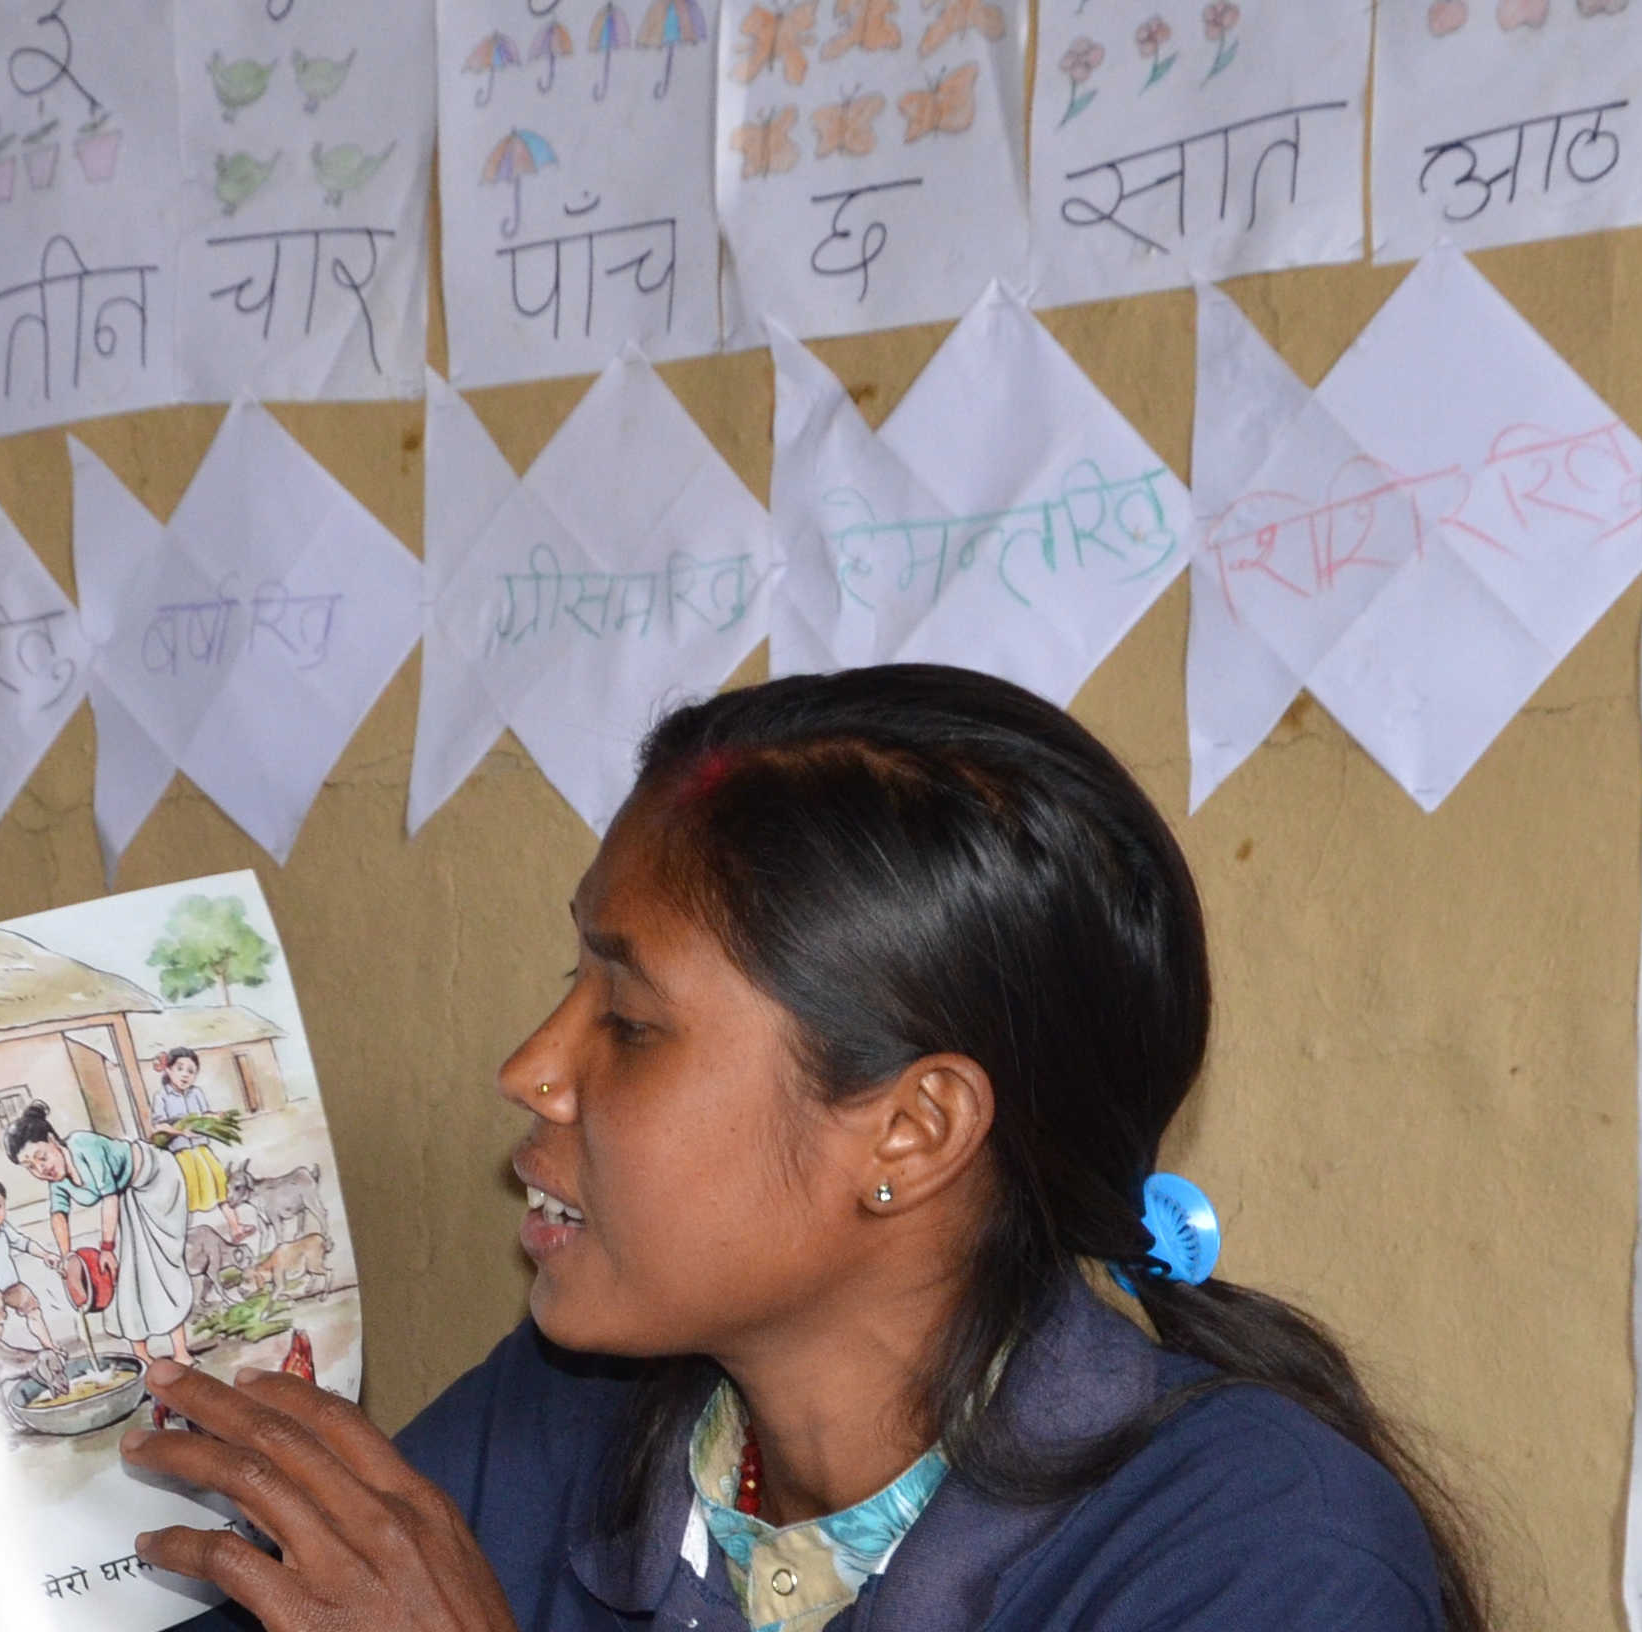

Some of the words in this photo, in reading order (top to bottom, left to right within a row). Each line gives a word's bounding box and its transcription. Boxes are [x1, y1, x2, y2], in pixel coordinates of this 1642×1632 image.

[1060, 100, 1348, 254] सात
[1418, 99, 1629, 222] आठ
[207, 227, 396, 375] चार
[811, 178, 924, 303] छ
[42, 1566, 90, 1599] मेरो
